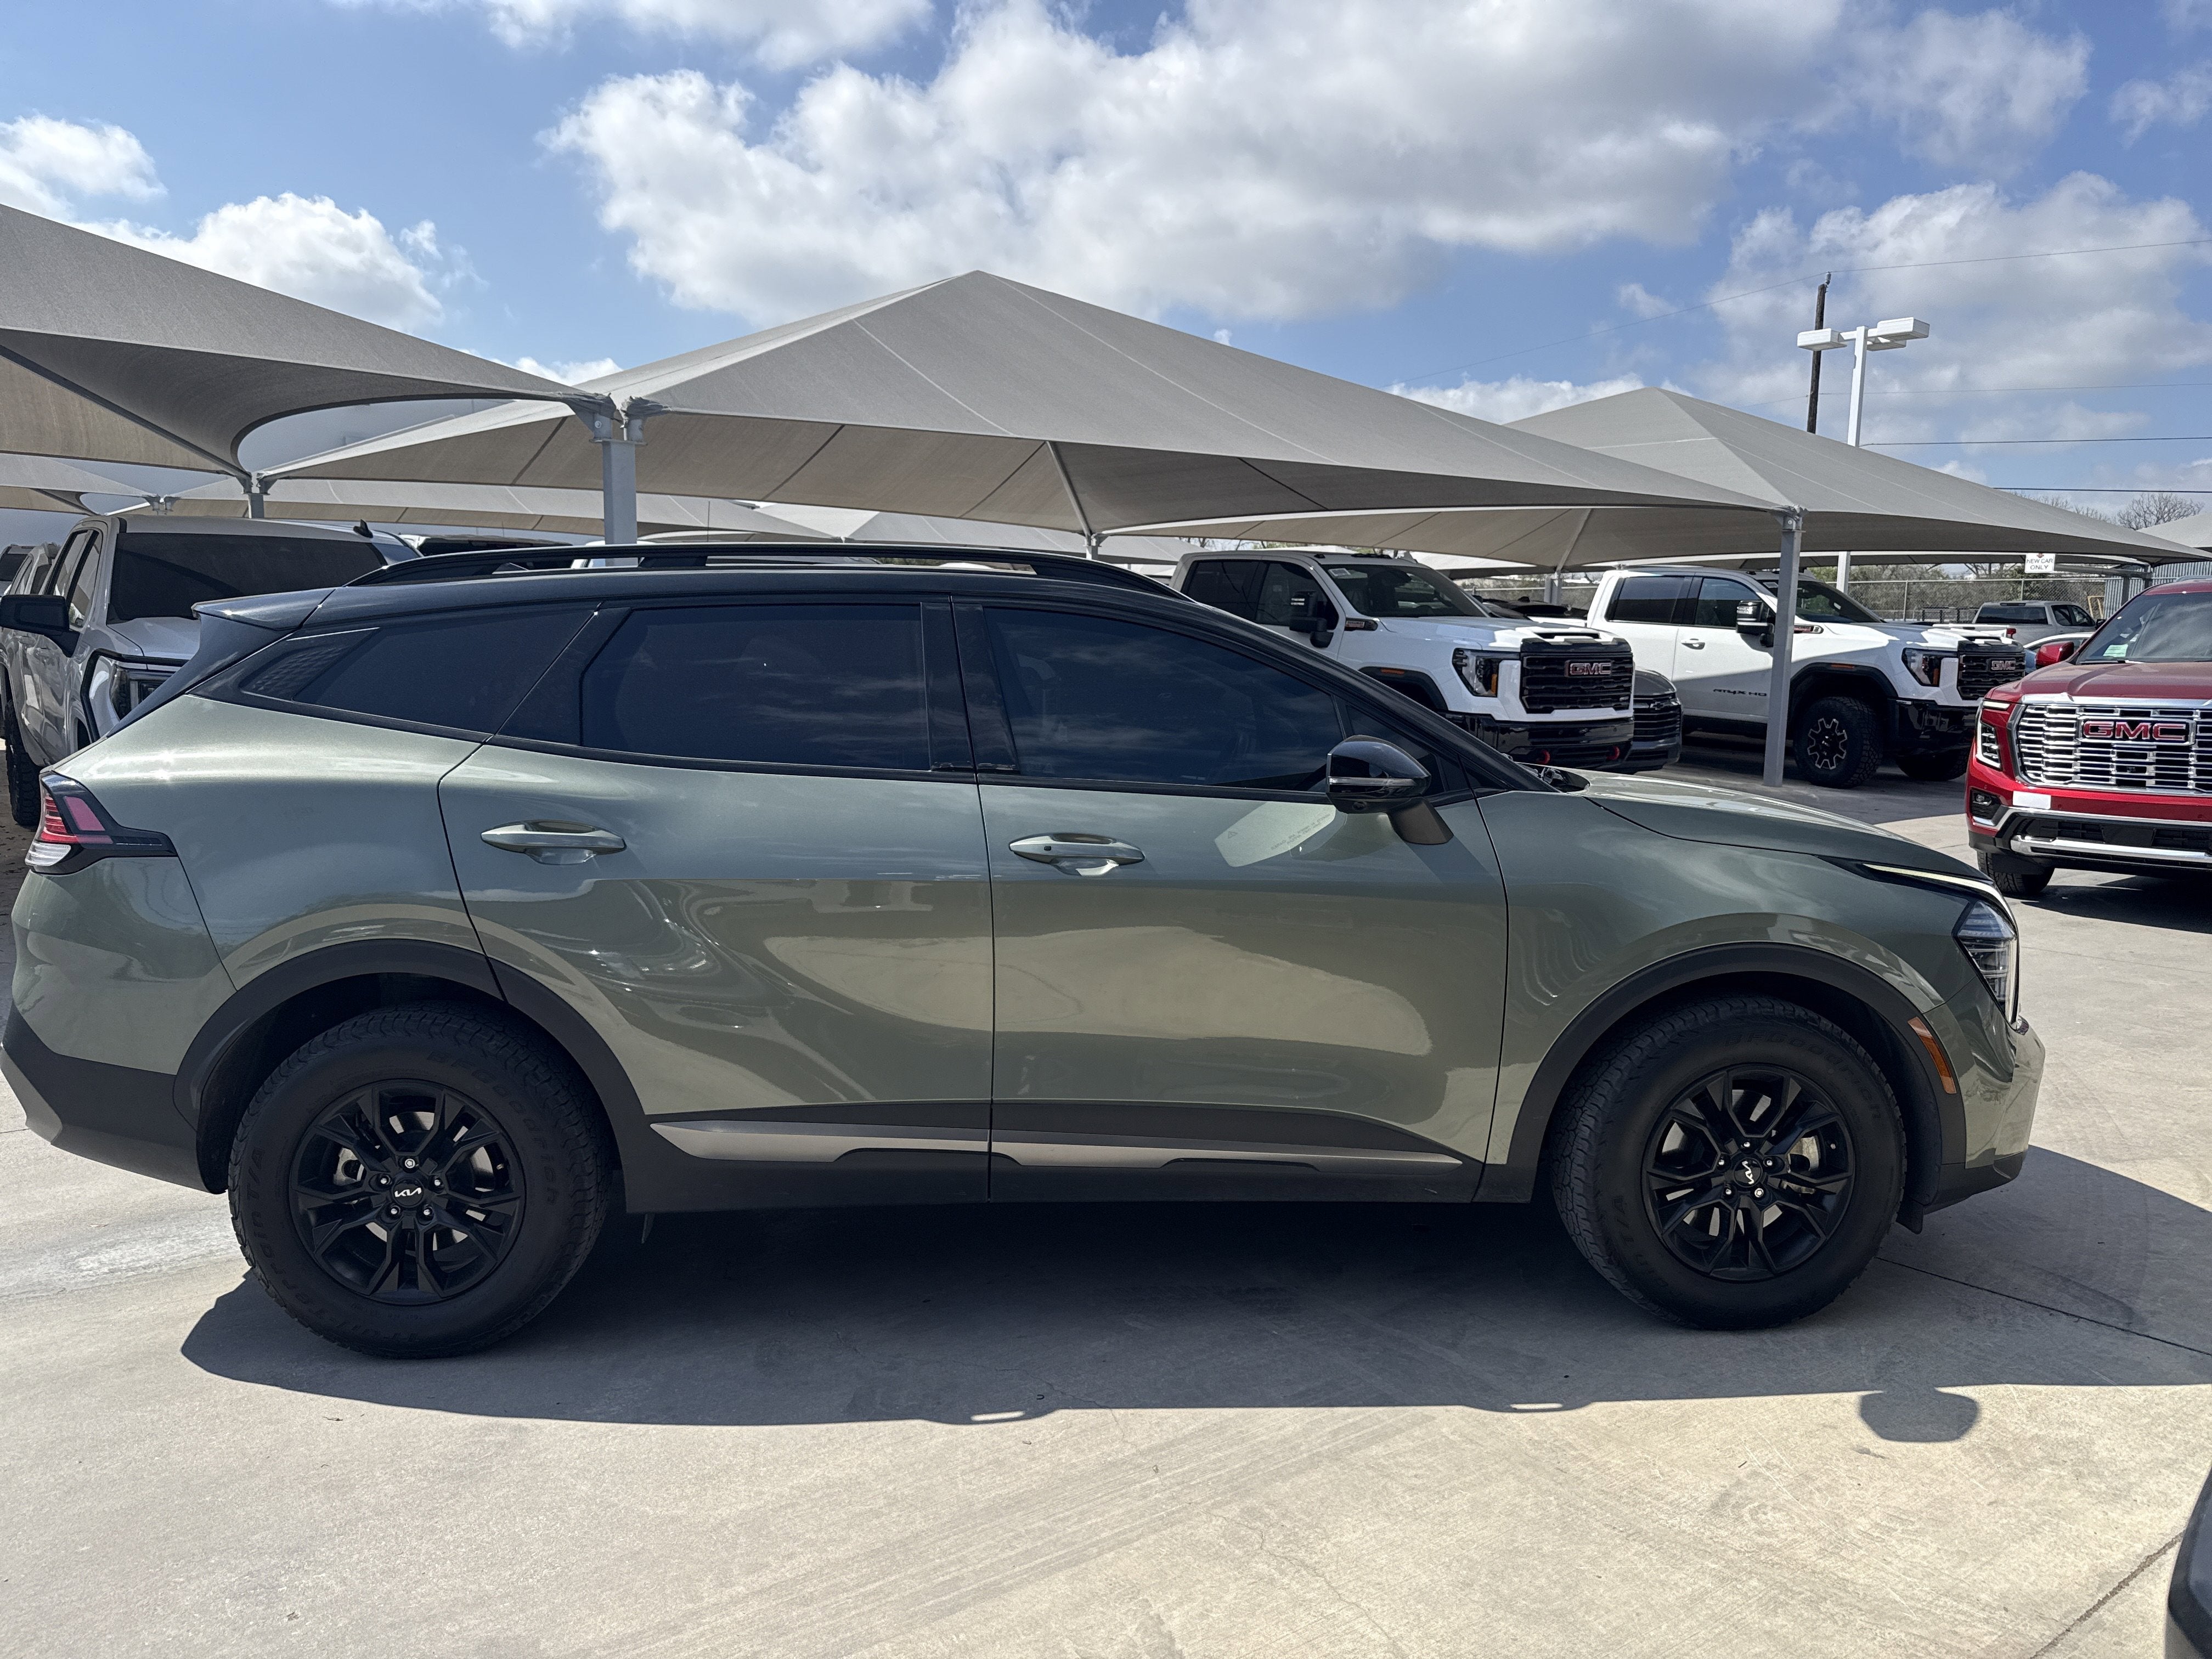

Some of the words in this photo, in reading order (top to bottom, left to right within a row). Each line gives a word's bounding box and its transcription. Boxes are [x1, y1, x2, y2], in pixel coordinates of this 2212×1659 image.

[1570, 662, 1612, 675] GMC
[1991, 660, 2016, 670] GMC
[2083, 720, 2186, 741] GMC
